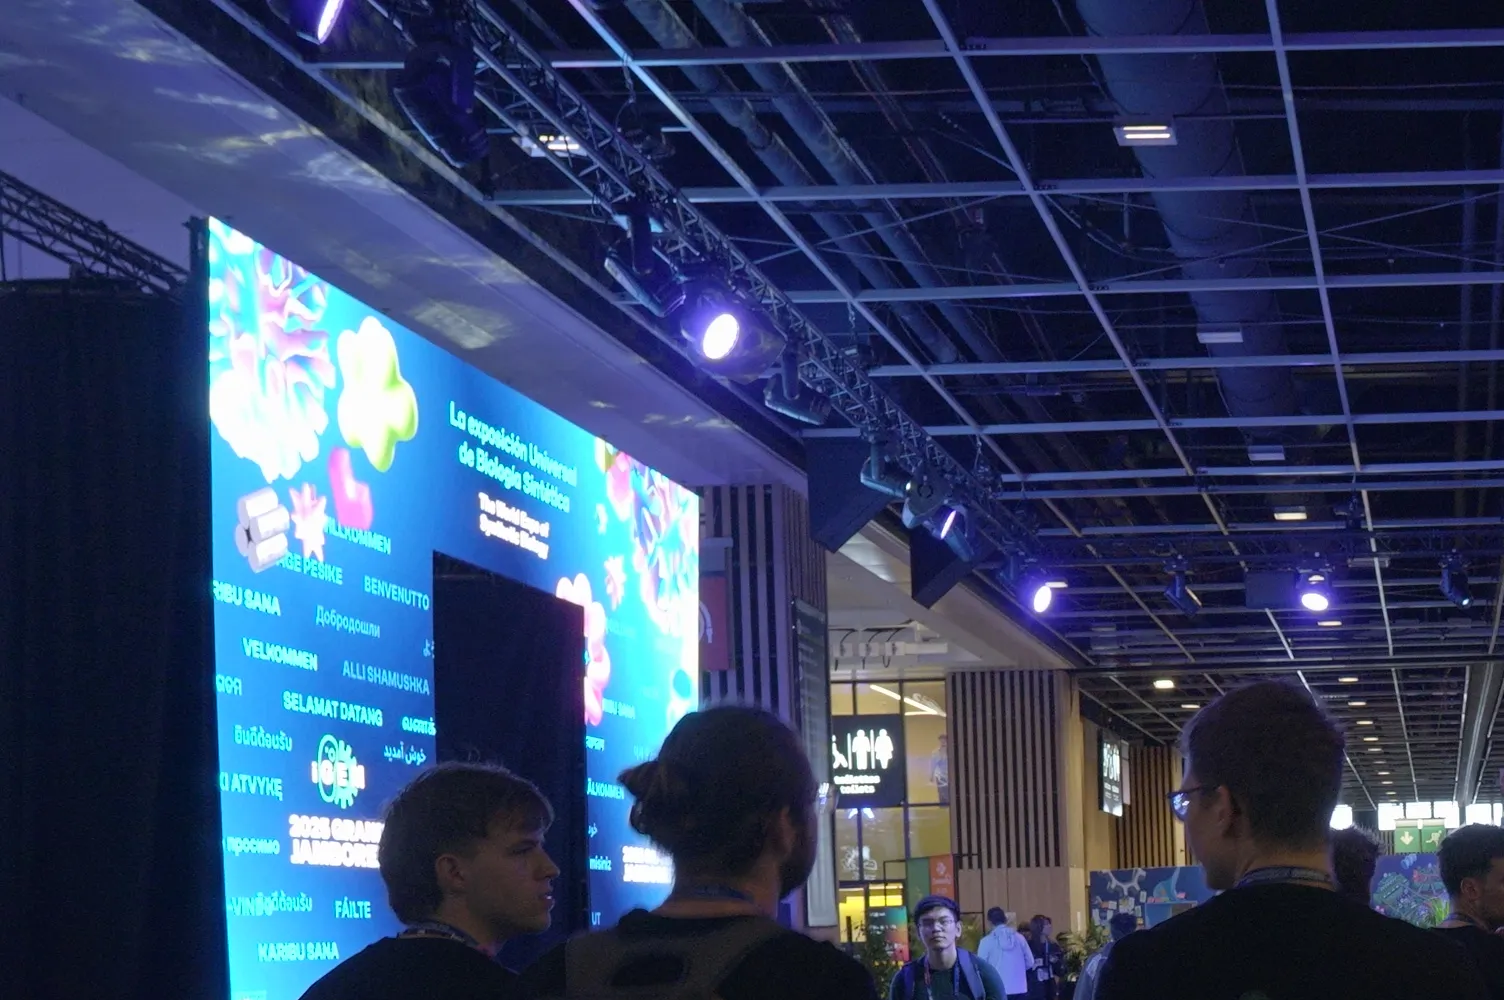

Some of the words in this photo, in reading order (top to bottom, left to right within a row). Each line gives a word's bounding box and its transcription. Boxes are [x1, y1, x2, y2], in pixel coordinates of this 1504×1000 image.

[450, 400, 467, 431] La
[467, 415, 527, 462] exposición
[528, 443, 578, 487] Universal
[458, 441, 475, 467] de
[325, 515, 392, 555] ILLKOMMEN
[303, 556, 343, 586] PESIKE
[244, 587, 282, 617] SANA
[363, 575, 430, 611] BENVENUTTO
[315, 604, 381, 639] Добродошли
[242, 637, 318, 672] VELKOMMEN
[342, 660, 367, 681] ALLI
[367, 665, 430, 696] SHAMUSHKA
[282, 690, 340, 720] SELAMAT
[340, 701, 383, 727] DATANG
[288, 813, 332, 840] 2025
[226, 836, 280, 856] просимо
[334, 896, 372, 919] FÁILTE
[257, 942, 306, 963] KARIBU
[306, 941, 340, 961] SANA
